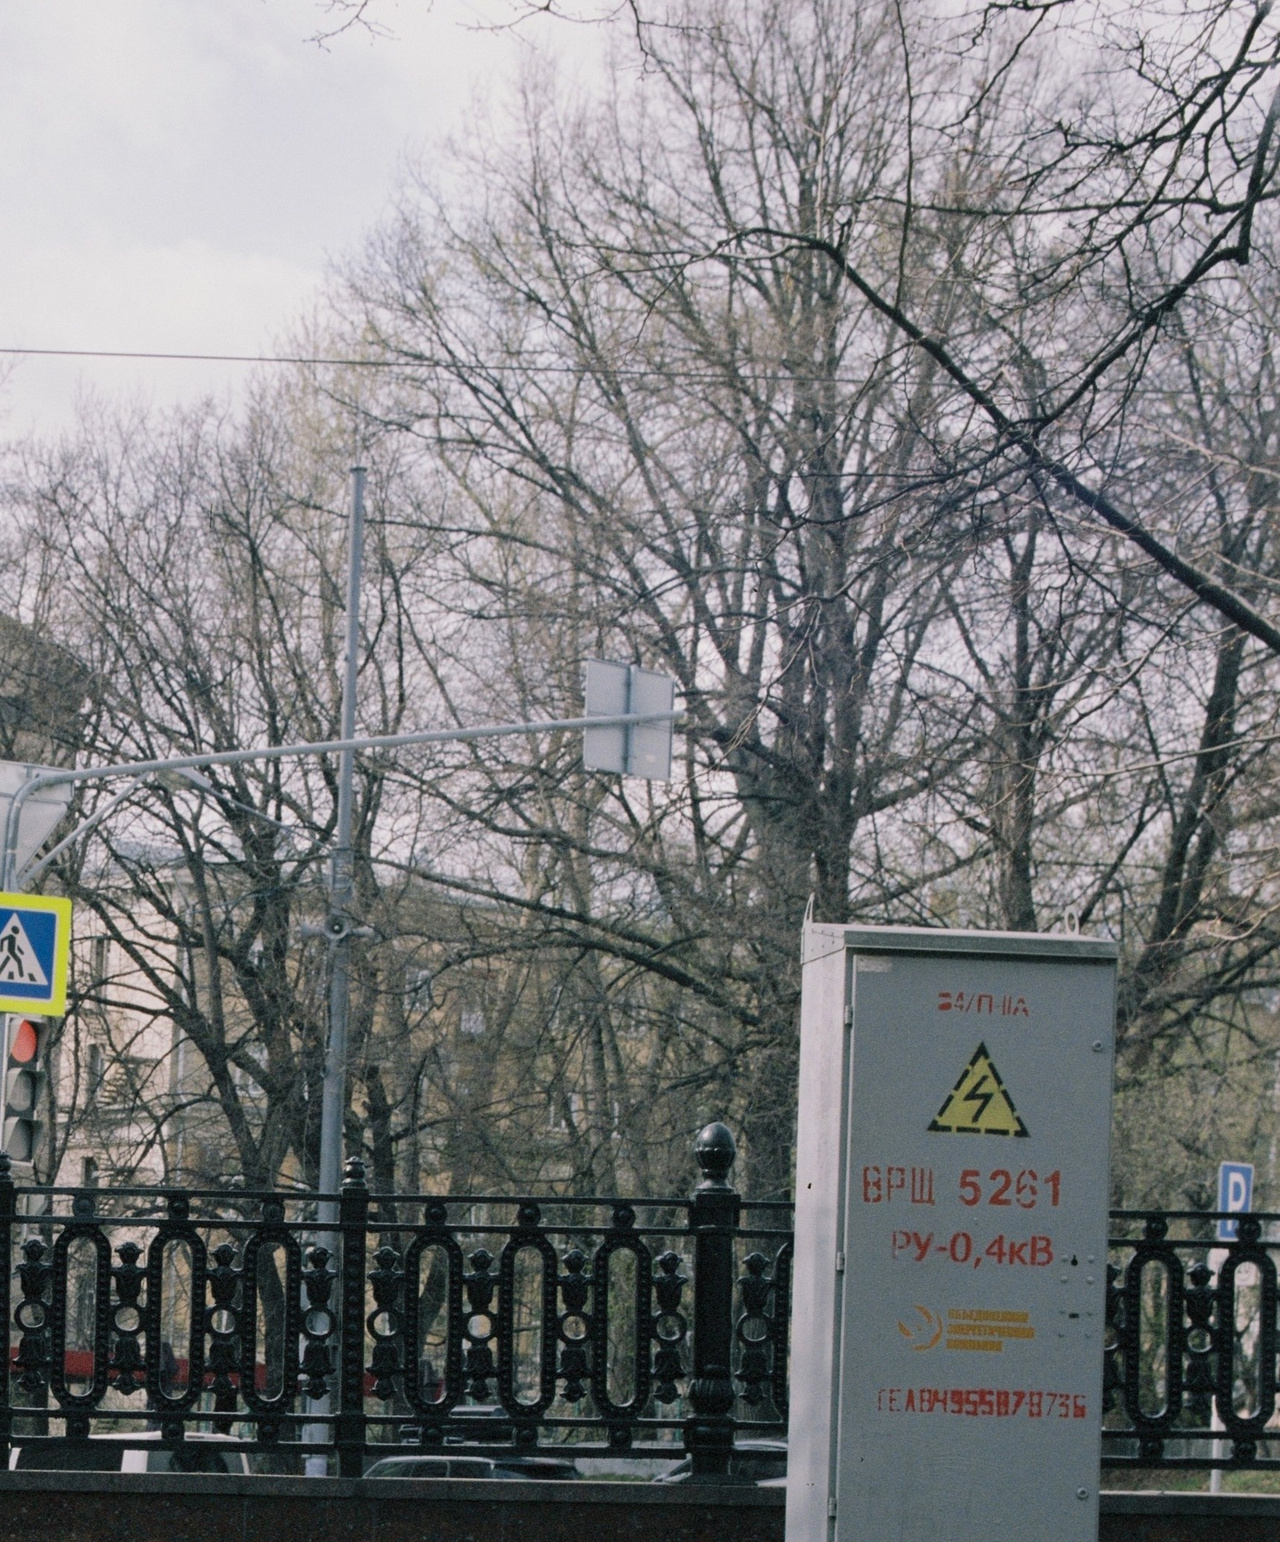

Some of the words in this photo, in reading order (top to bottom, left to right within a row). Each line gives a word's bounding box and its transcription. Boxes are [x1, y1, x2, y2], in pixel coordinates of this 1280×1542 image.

[863, 1166, 935, 1206] ВРЩ
[958, 1168, 1061, 1209] 5261
[1228, 1171, 1247, 1232] P
